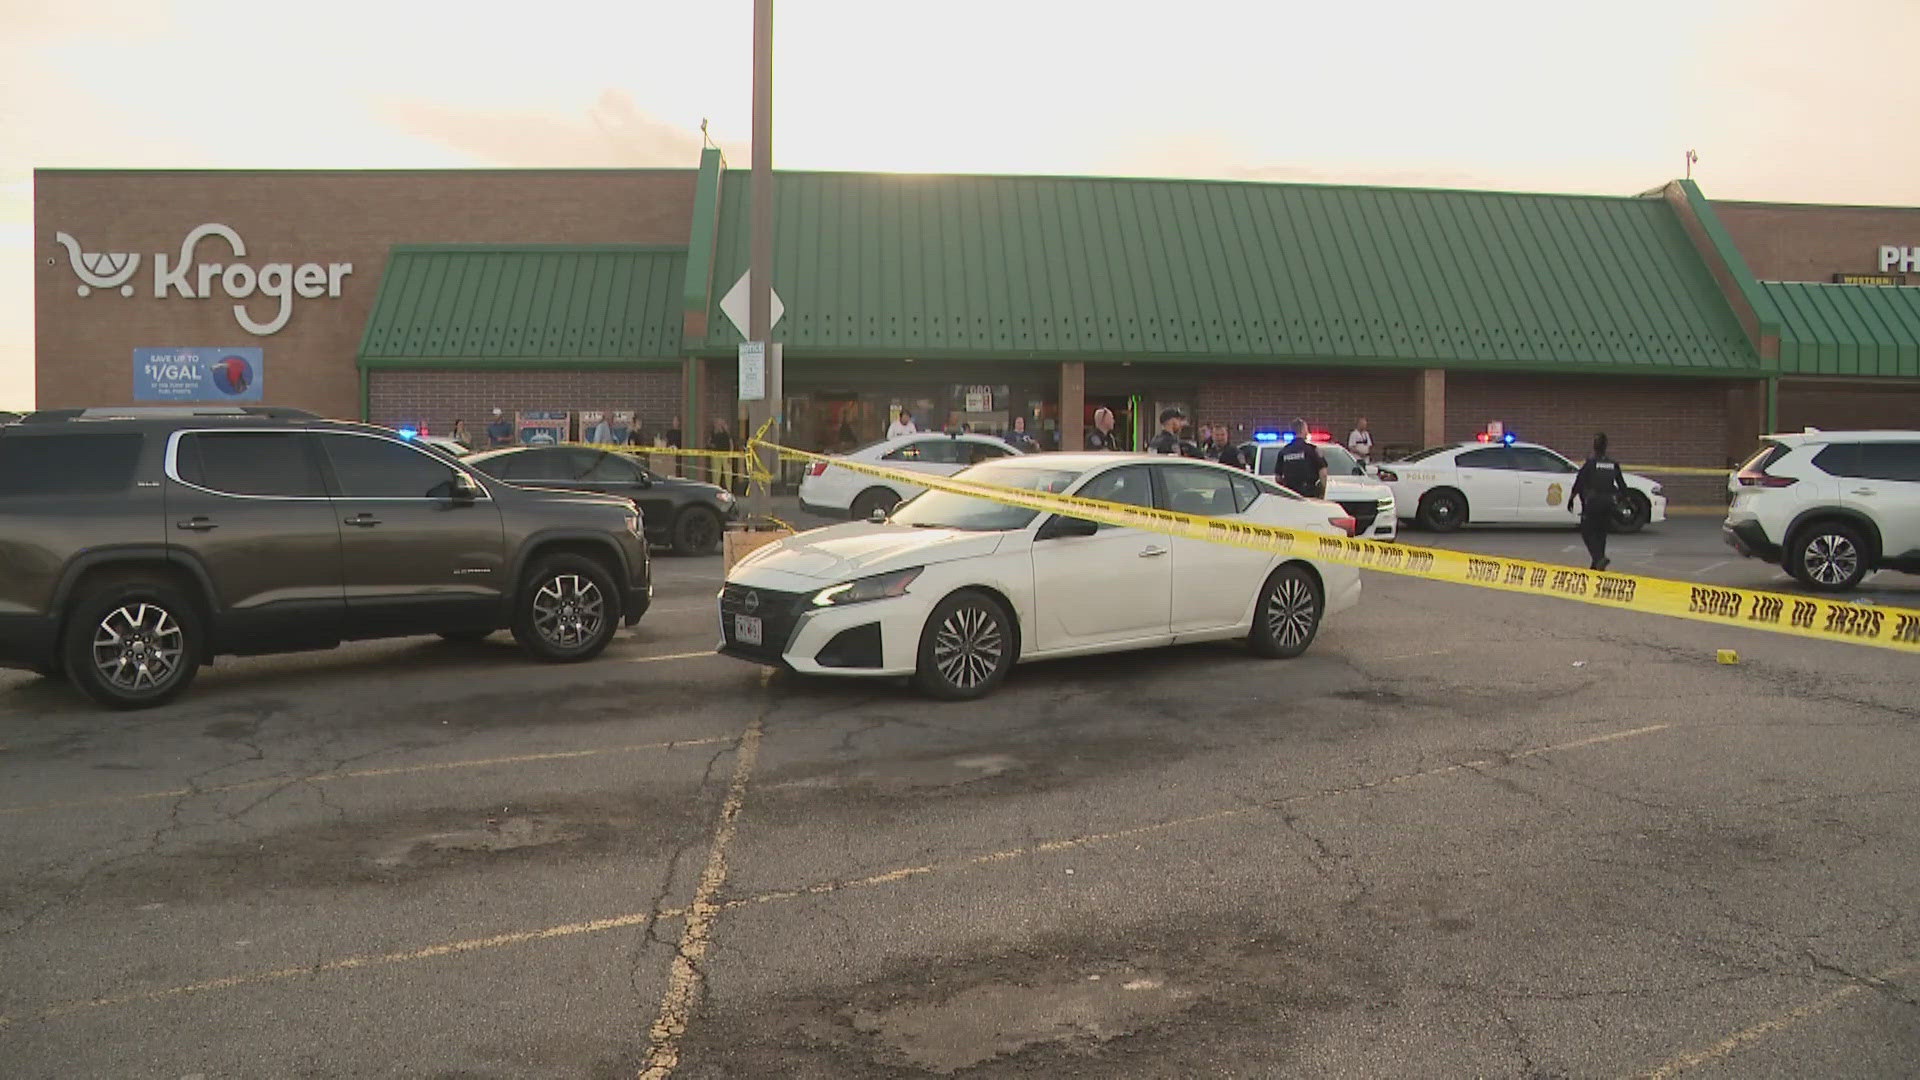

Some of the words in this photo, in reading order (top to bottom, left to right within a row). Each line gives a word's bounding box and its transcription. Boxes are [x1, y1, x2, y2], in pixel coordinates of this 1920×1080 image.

[1880, 245, 1920, 273] PH
[155, 223, 352, 335] Kroger
[151, 355, 171, 363] SAVE
[174, 355, 185, 363] UP
[187, 355, 200, 363] TO
[1466, 558, 1500, 582] CROSS
[1530, 567, 1548, 588] DO
[1552, 569, 1589, 595] SCENE
[1593, 575, 1637, 602] CRIME
[1689, 587, 1743, 618] CROSS
[1748, 595, 1784, 624] NOT
[1791, 600, 1818, 629] DO
[1824, 605, 1885, 638] SCENE
